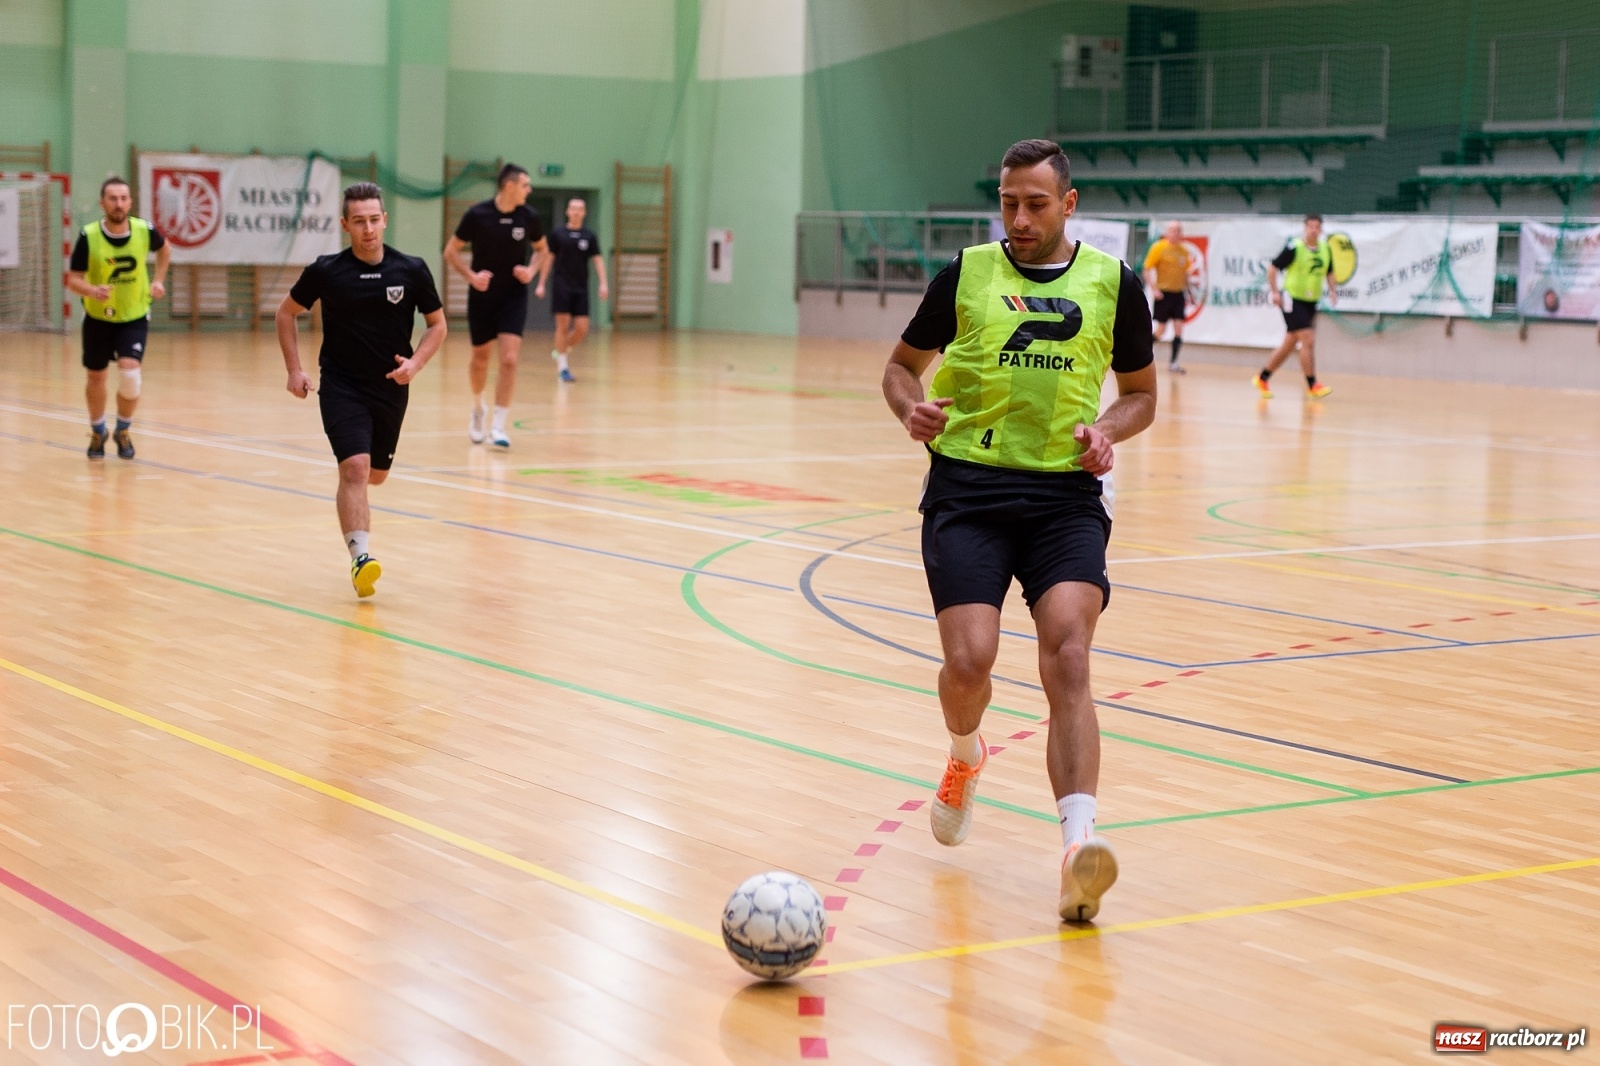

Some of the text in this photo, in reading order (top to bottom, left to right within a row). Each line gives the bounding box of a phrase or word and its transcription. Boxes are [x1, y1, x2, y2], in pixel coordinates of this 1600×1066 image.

[239, 187, 322, 210] MIASTO
[998, 352, 1075, 372] PATRICK
[980, 428, 994, 449] 4
